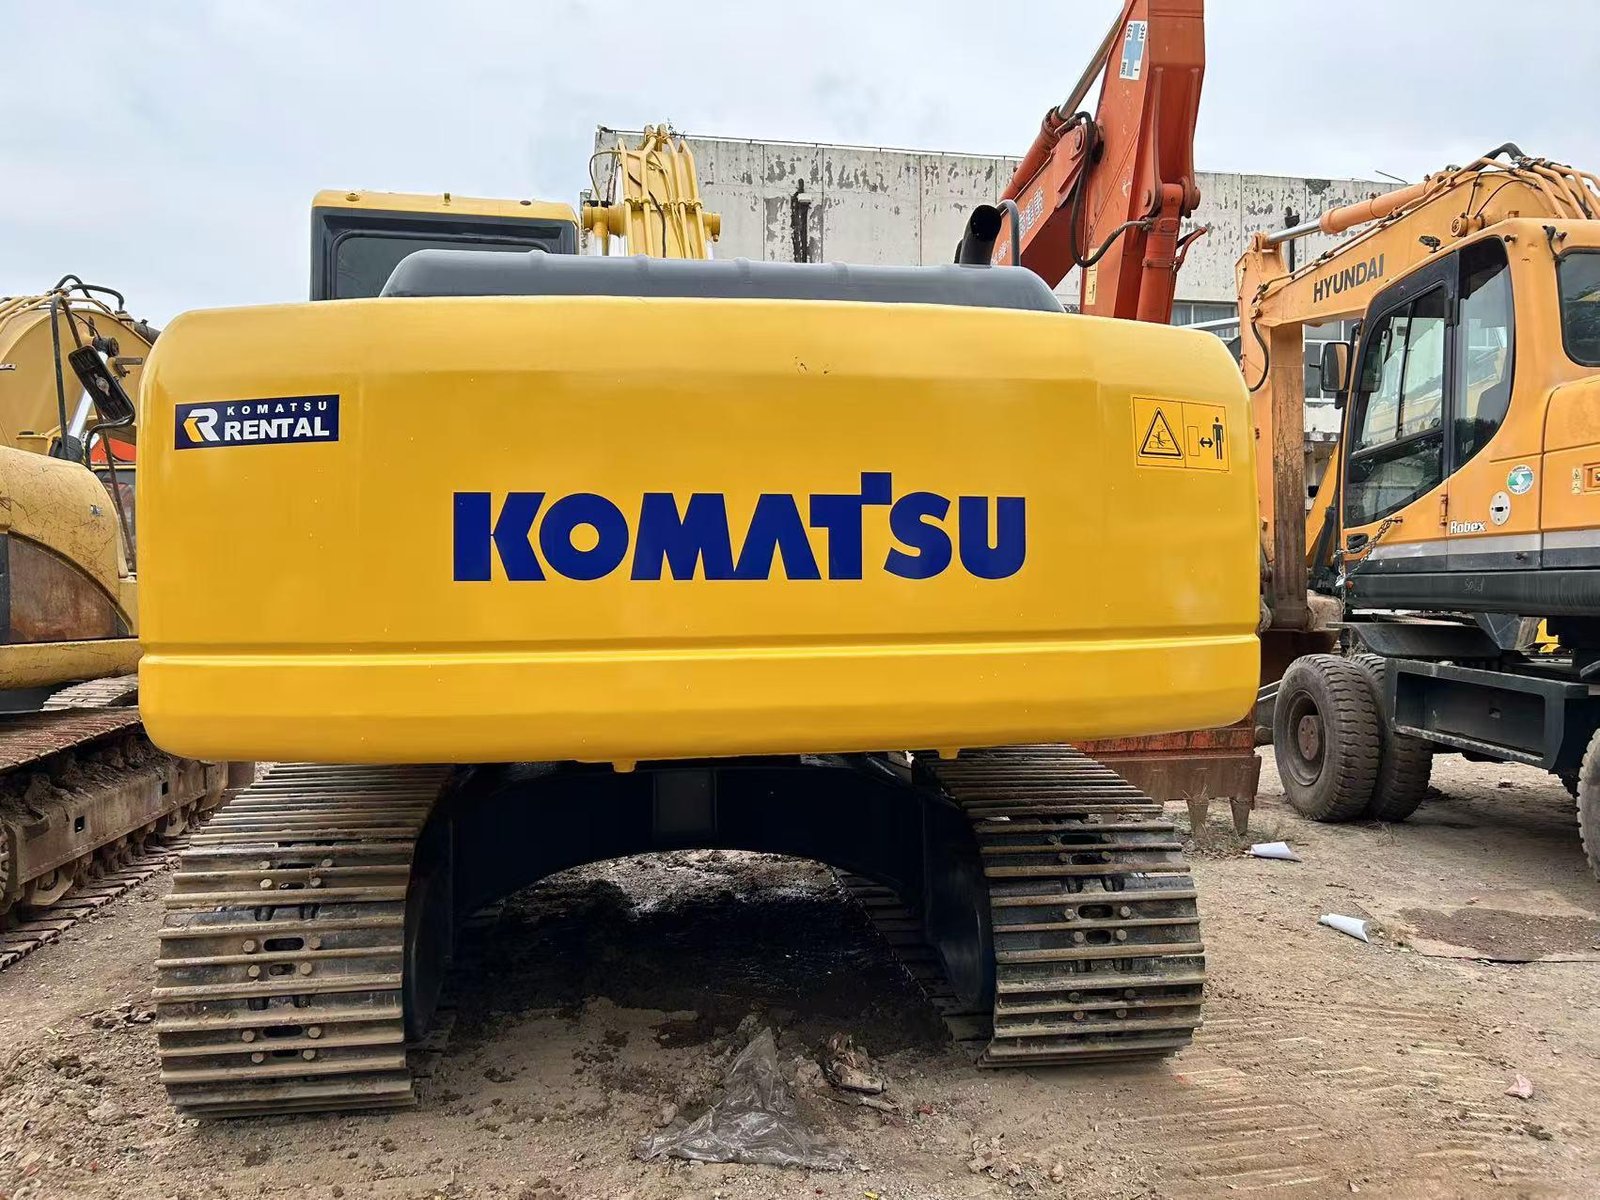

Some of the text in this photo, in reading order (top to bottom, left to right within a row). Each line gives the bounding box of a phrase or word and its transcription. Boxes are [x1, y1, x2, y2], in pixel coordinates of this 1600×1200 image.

[1313, 253, 1385, 303] HYUNDAI
[226, 401, 329, 416] KOMATSU
[224, 417, 330, 441] RENTAL
[453, 472, 1026, 581] KOMATSU
[1449, 520, 1487, 534] Robex
